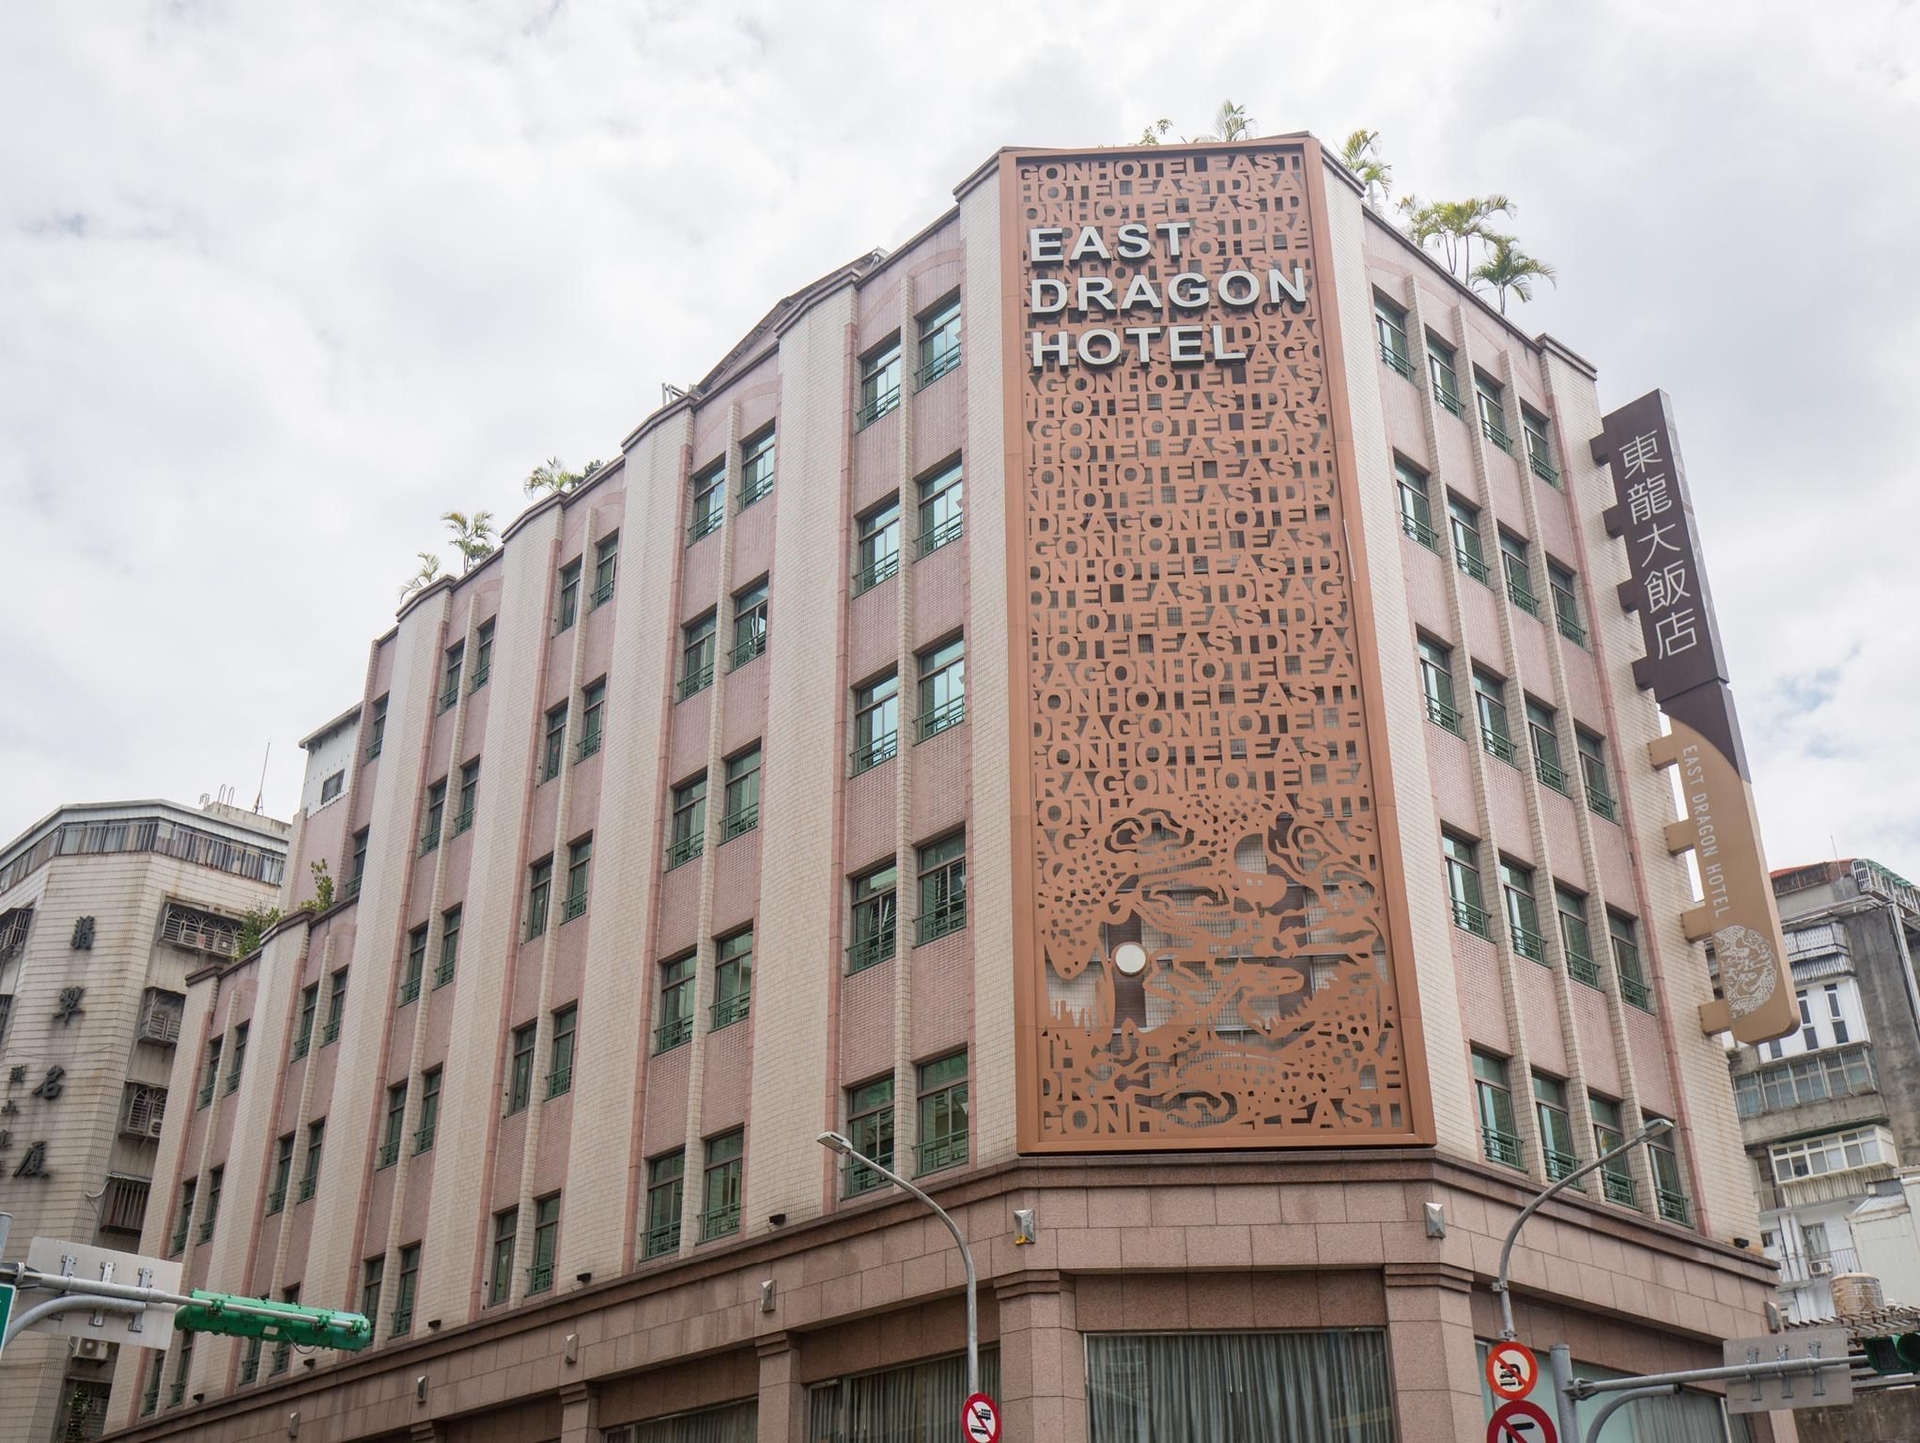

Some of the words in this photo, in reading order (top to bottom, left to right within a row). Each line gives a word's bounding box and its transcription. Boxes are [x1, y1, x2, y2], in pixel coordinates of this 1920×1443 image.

[1030, 222, 1190, 264] EAST
[1031, 268, 1307, 314] DRAGON
[1032, 325, 1247, 367] HOTEL
[1619, 430, 1697, 660] 東龍大飯店
[1683, 744, 1704, 785] EAST
[1692, 792, 1718, 857] DRAGON
[1706, 863, 1730, 918] HOTEL
